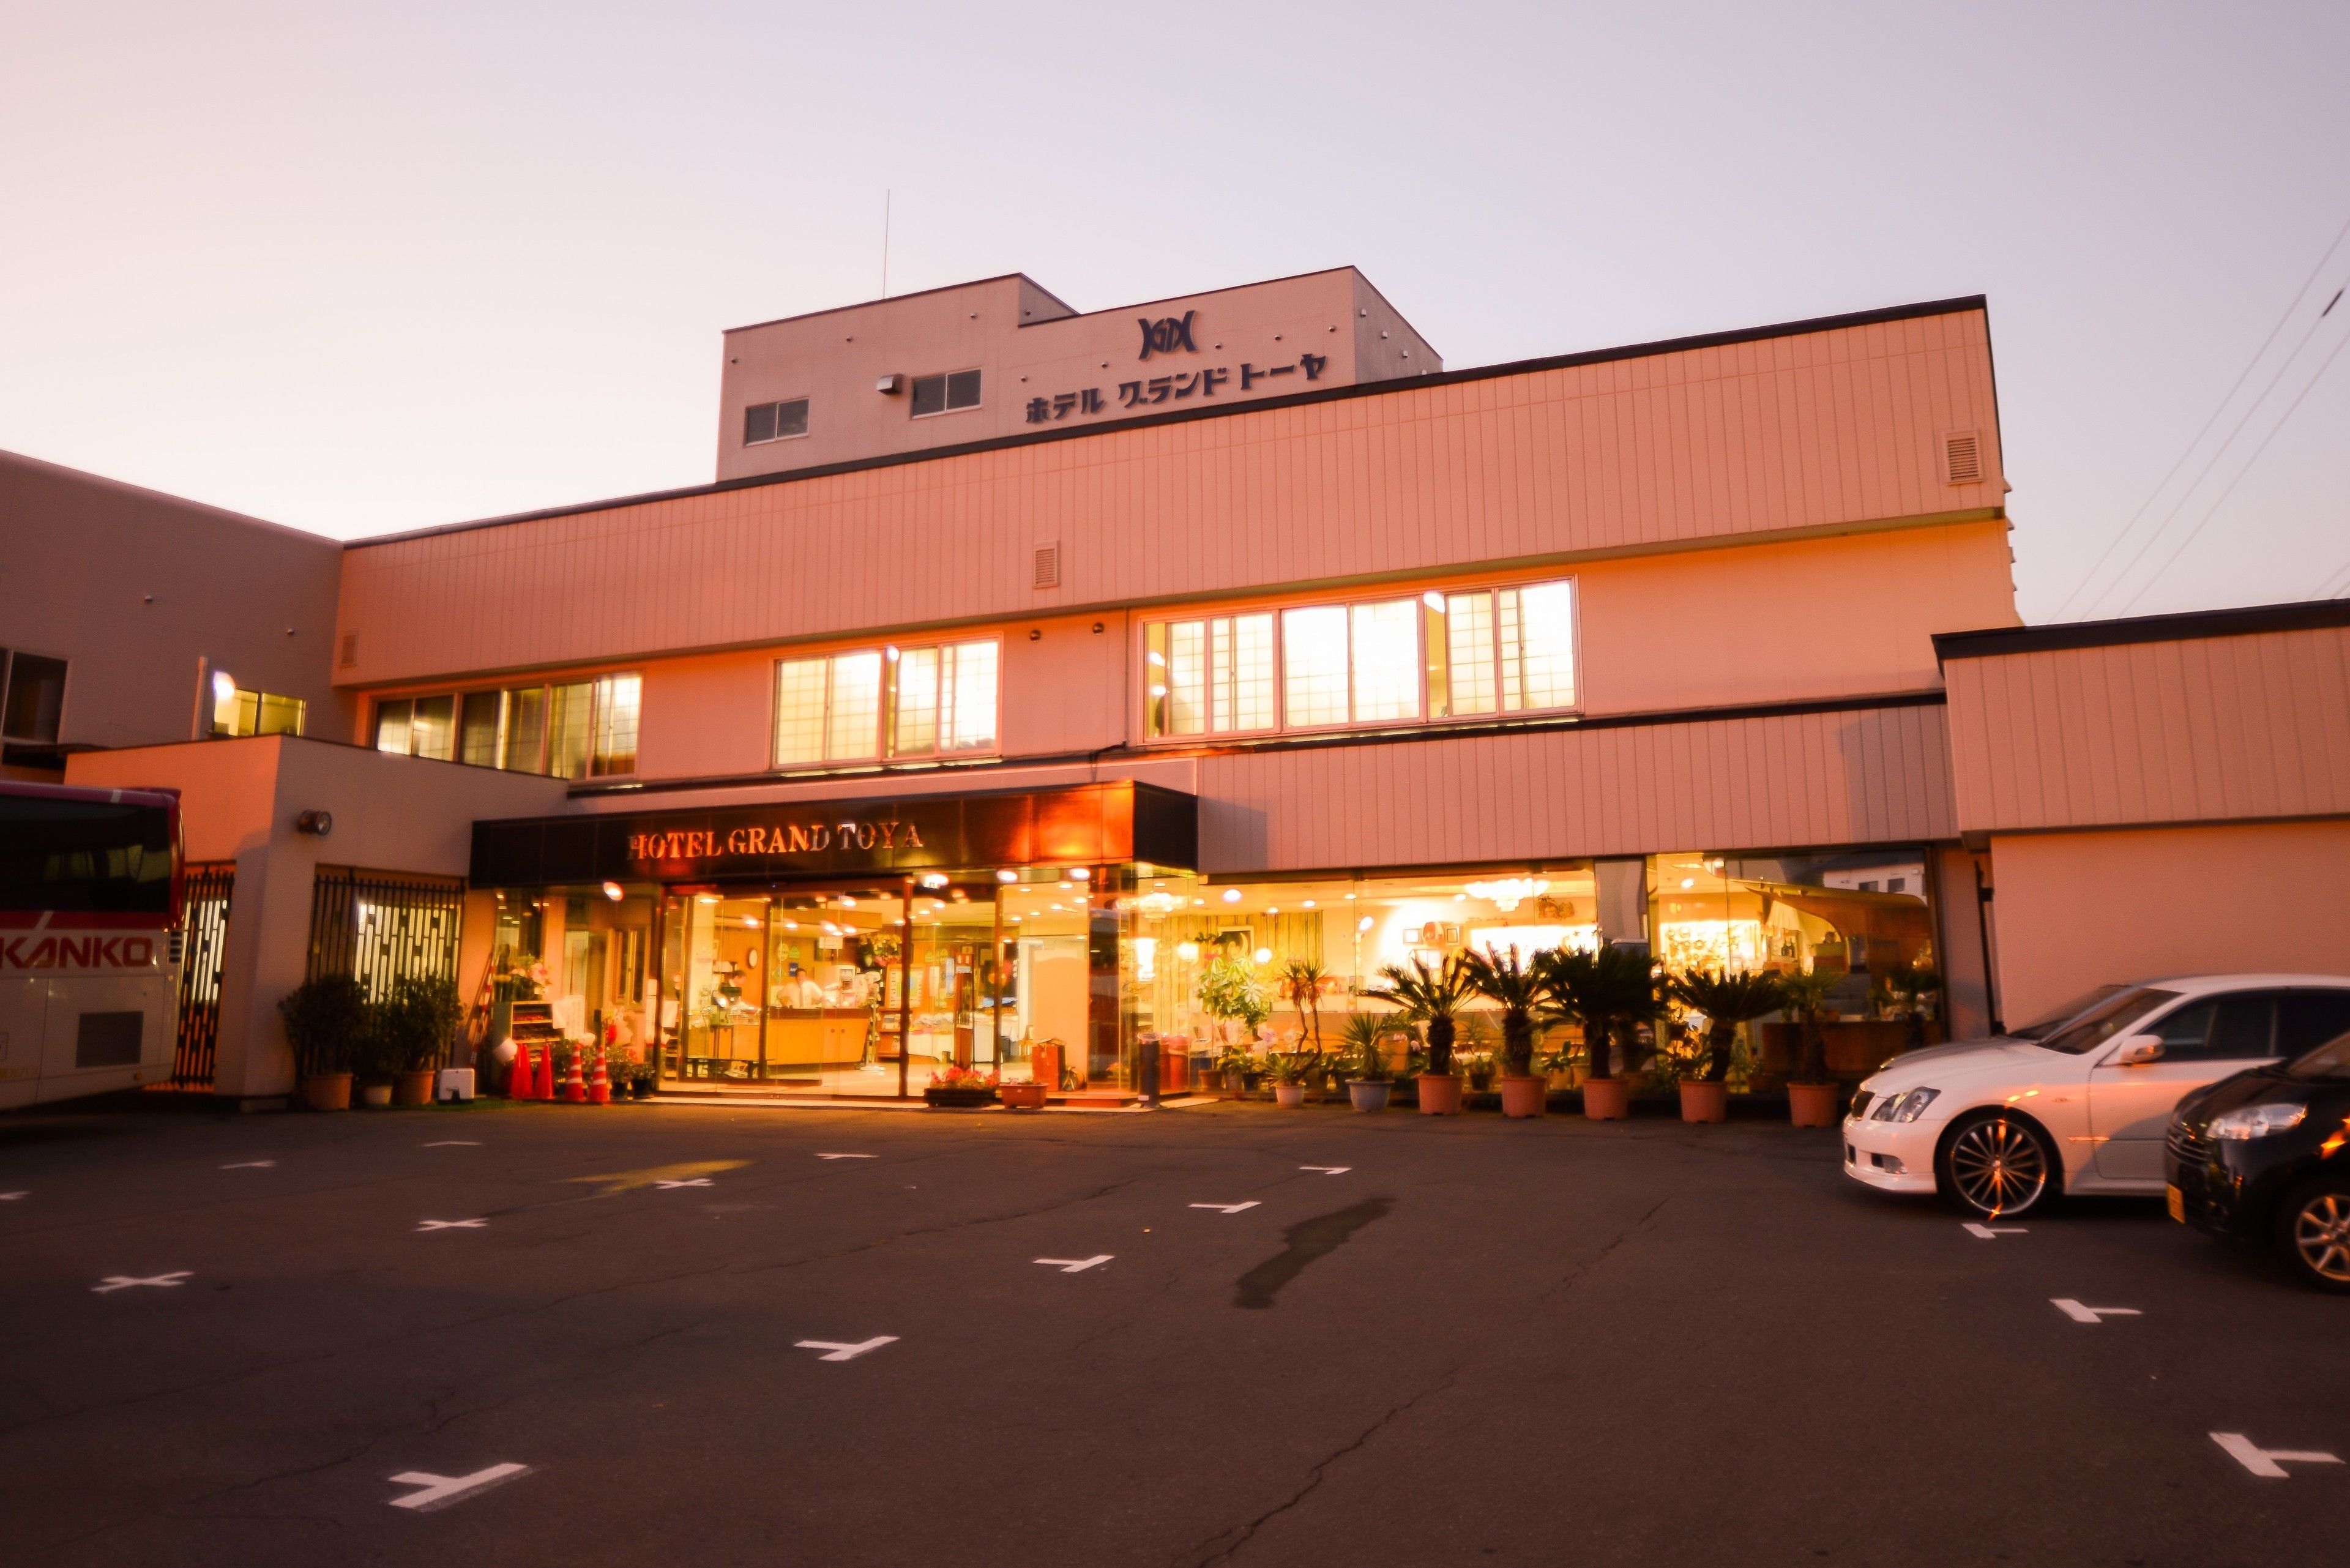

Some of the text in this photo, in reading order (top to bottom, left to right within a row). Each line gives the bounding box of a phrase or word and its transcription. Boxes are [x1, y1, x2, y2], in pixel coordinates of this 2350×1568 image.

[1026, 387, 1105, 423] ホテル
[1240, 353, 1327, 390] トーヤ
[627, 821, 925, 860] HOTEL GRAND TOYA
[0, 936, 153, 969] KANKO
